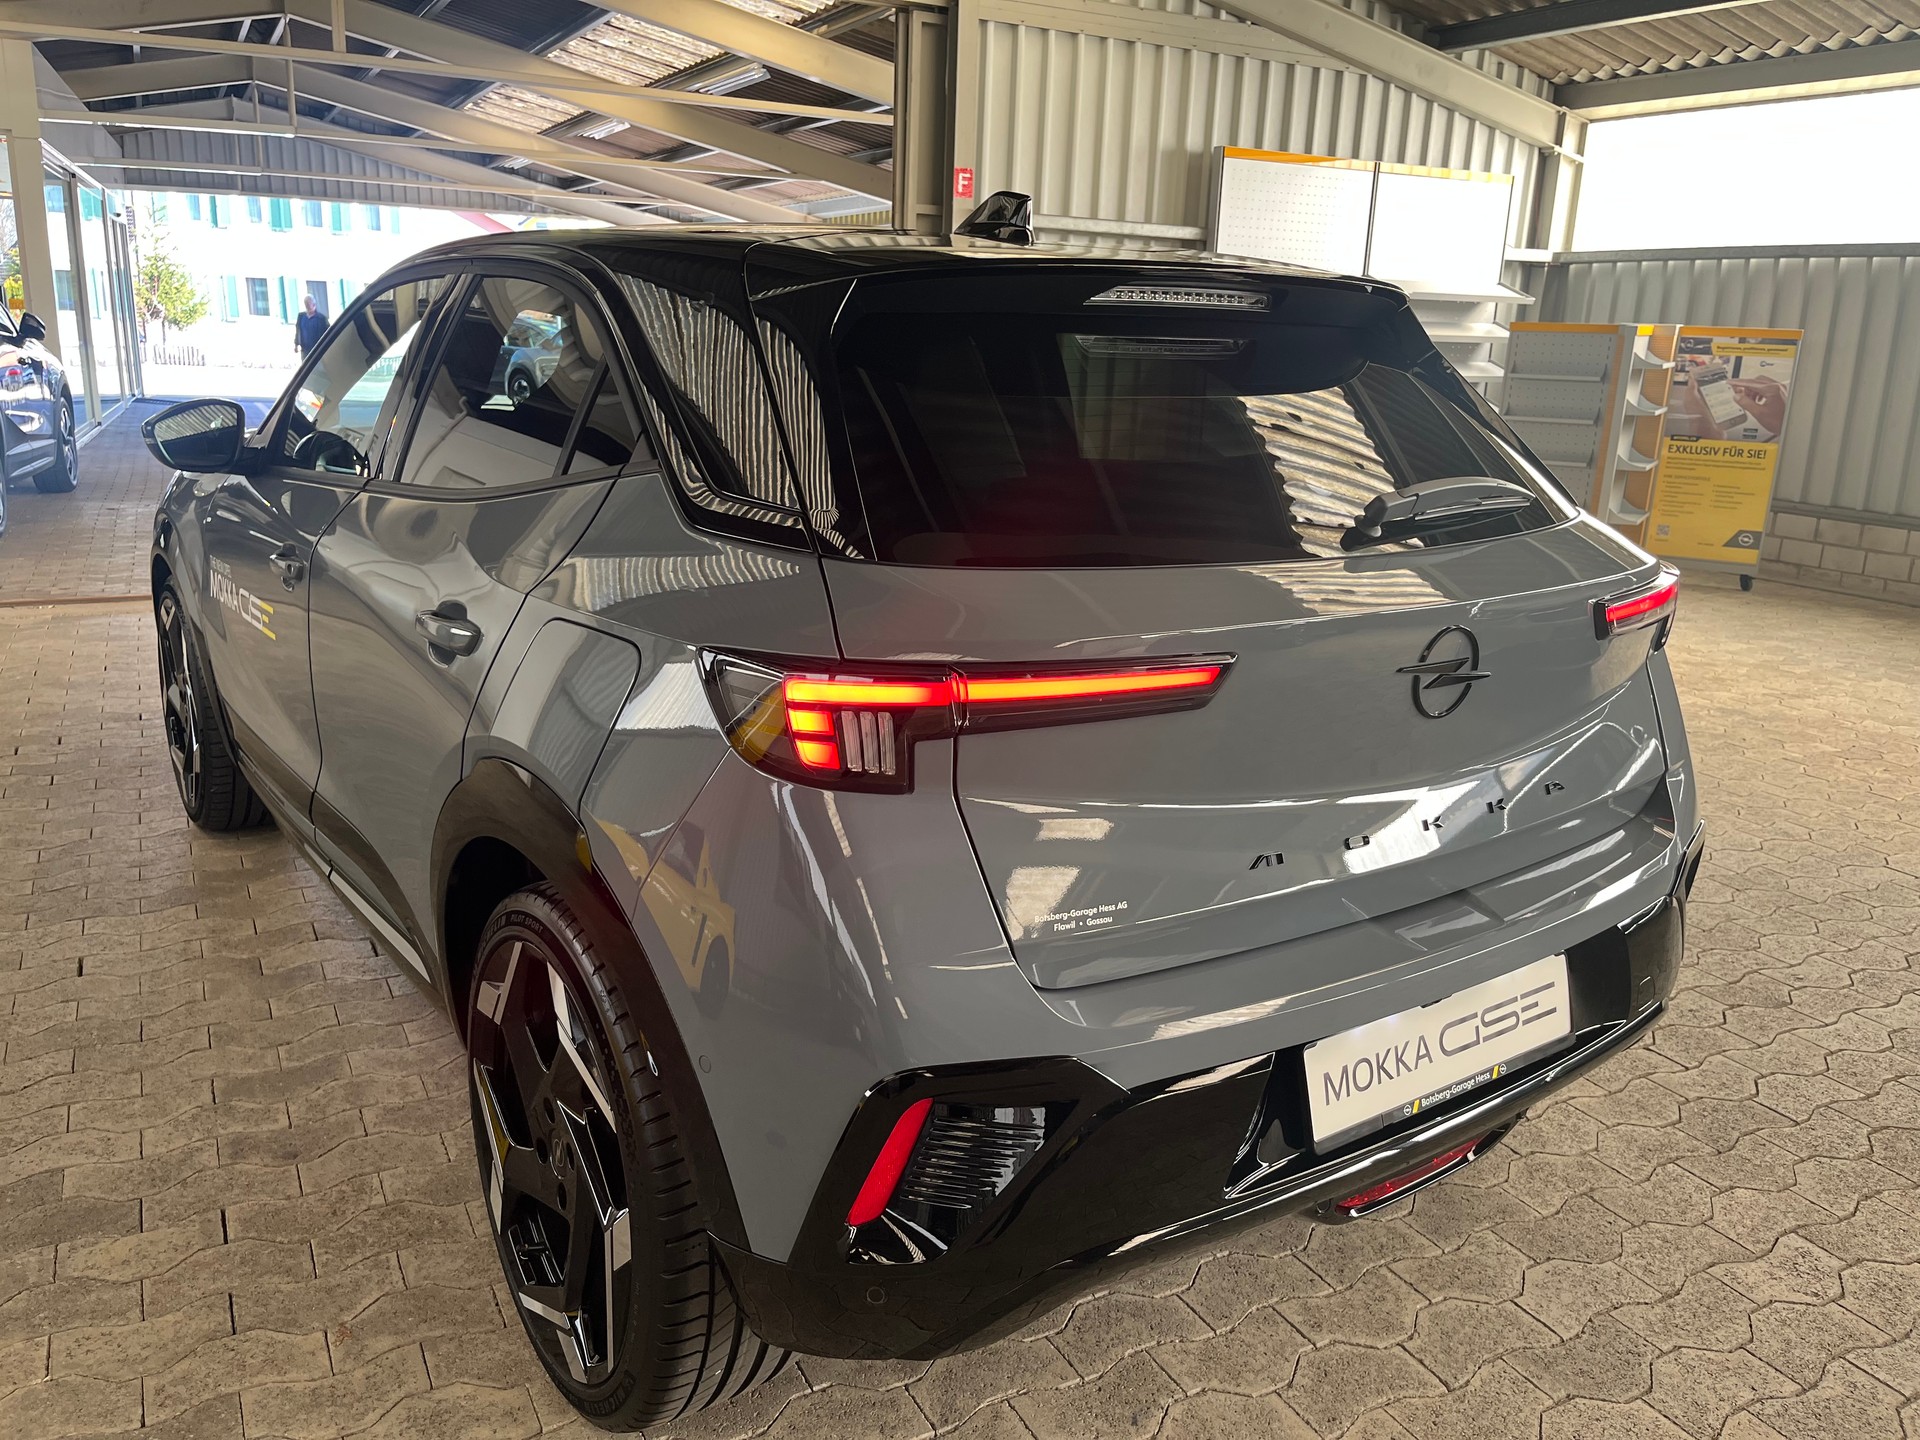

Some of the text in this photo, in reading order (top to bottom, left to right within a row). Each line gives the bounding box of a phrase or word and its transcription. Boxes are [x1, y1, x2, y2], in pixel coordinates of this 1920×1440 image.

[957, 173, 971, 193] F
[1667, 444, 1767, 460] EXKLUSIV FÜR SIE!
[210, 569, 276, 640] MOKKA GSE
[1098, 904, 1116, 914] Hess
[1116, 901, 1128, 911] AG
[1053, 916, 1113, 932] Flawil Gossau
[1322, 981, 1557, 1106] MOKKA GSE
[1421, 1072, 1491, 1107] Botsberg-Garage Hess
